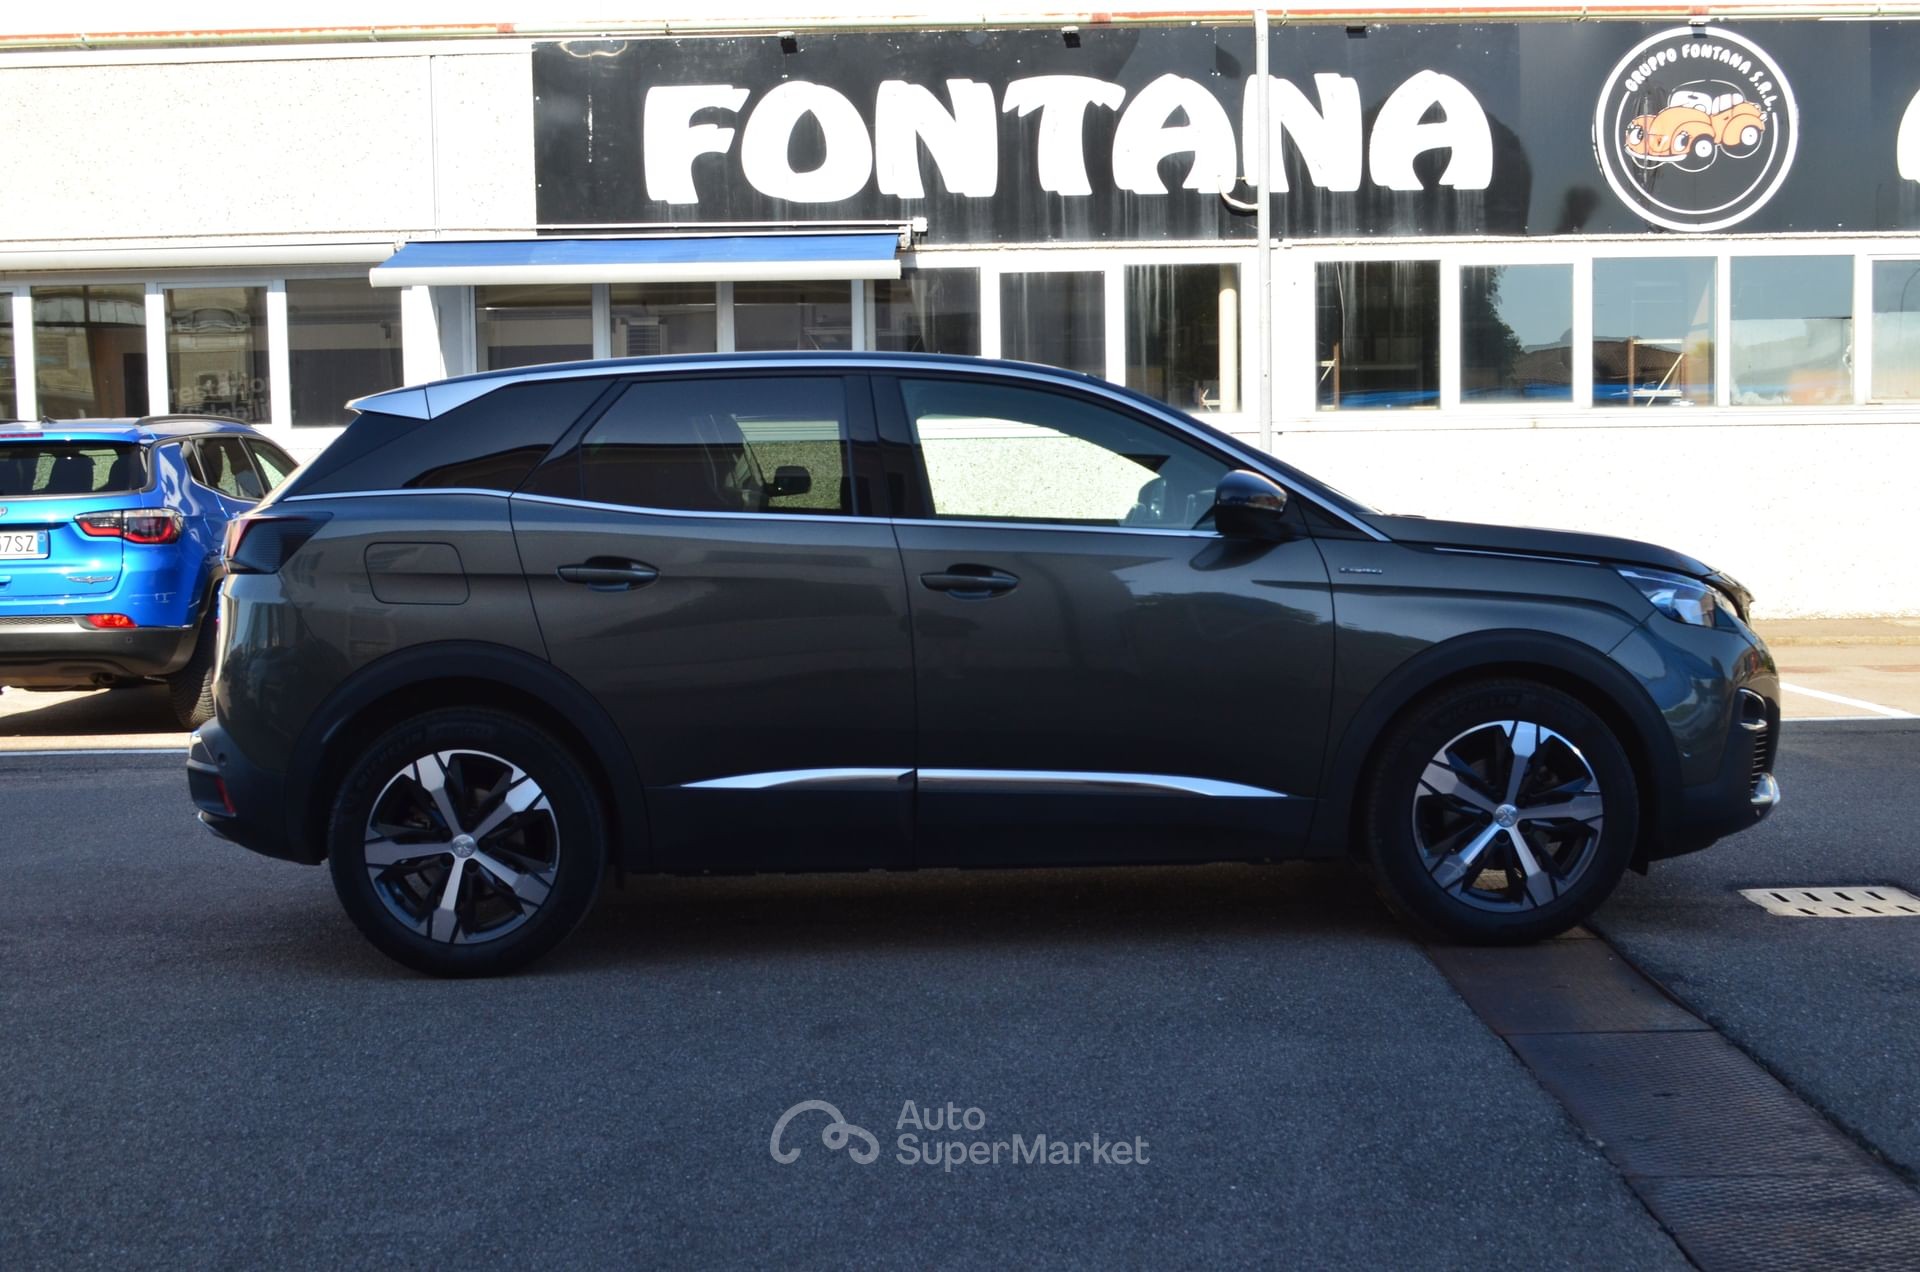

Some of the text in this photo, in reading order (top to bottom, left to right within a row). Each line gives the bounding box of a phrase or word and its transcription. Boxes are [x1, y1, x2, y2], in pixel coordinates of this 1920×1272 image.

[1625, 43, 1778, 112] GRUPPO FONTANA S.R.L.
[643, 69, 1494, 204] FONTANA
